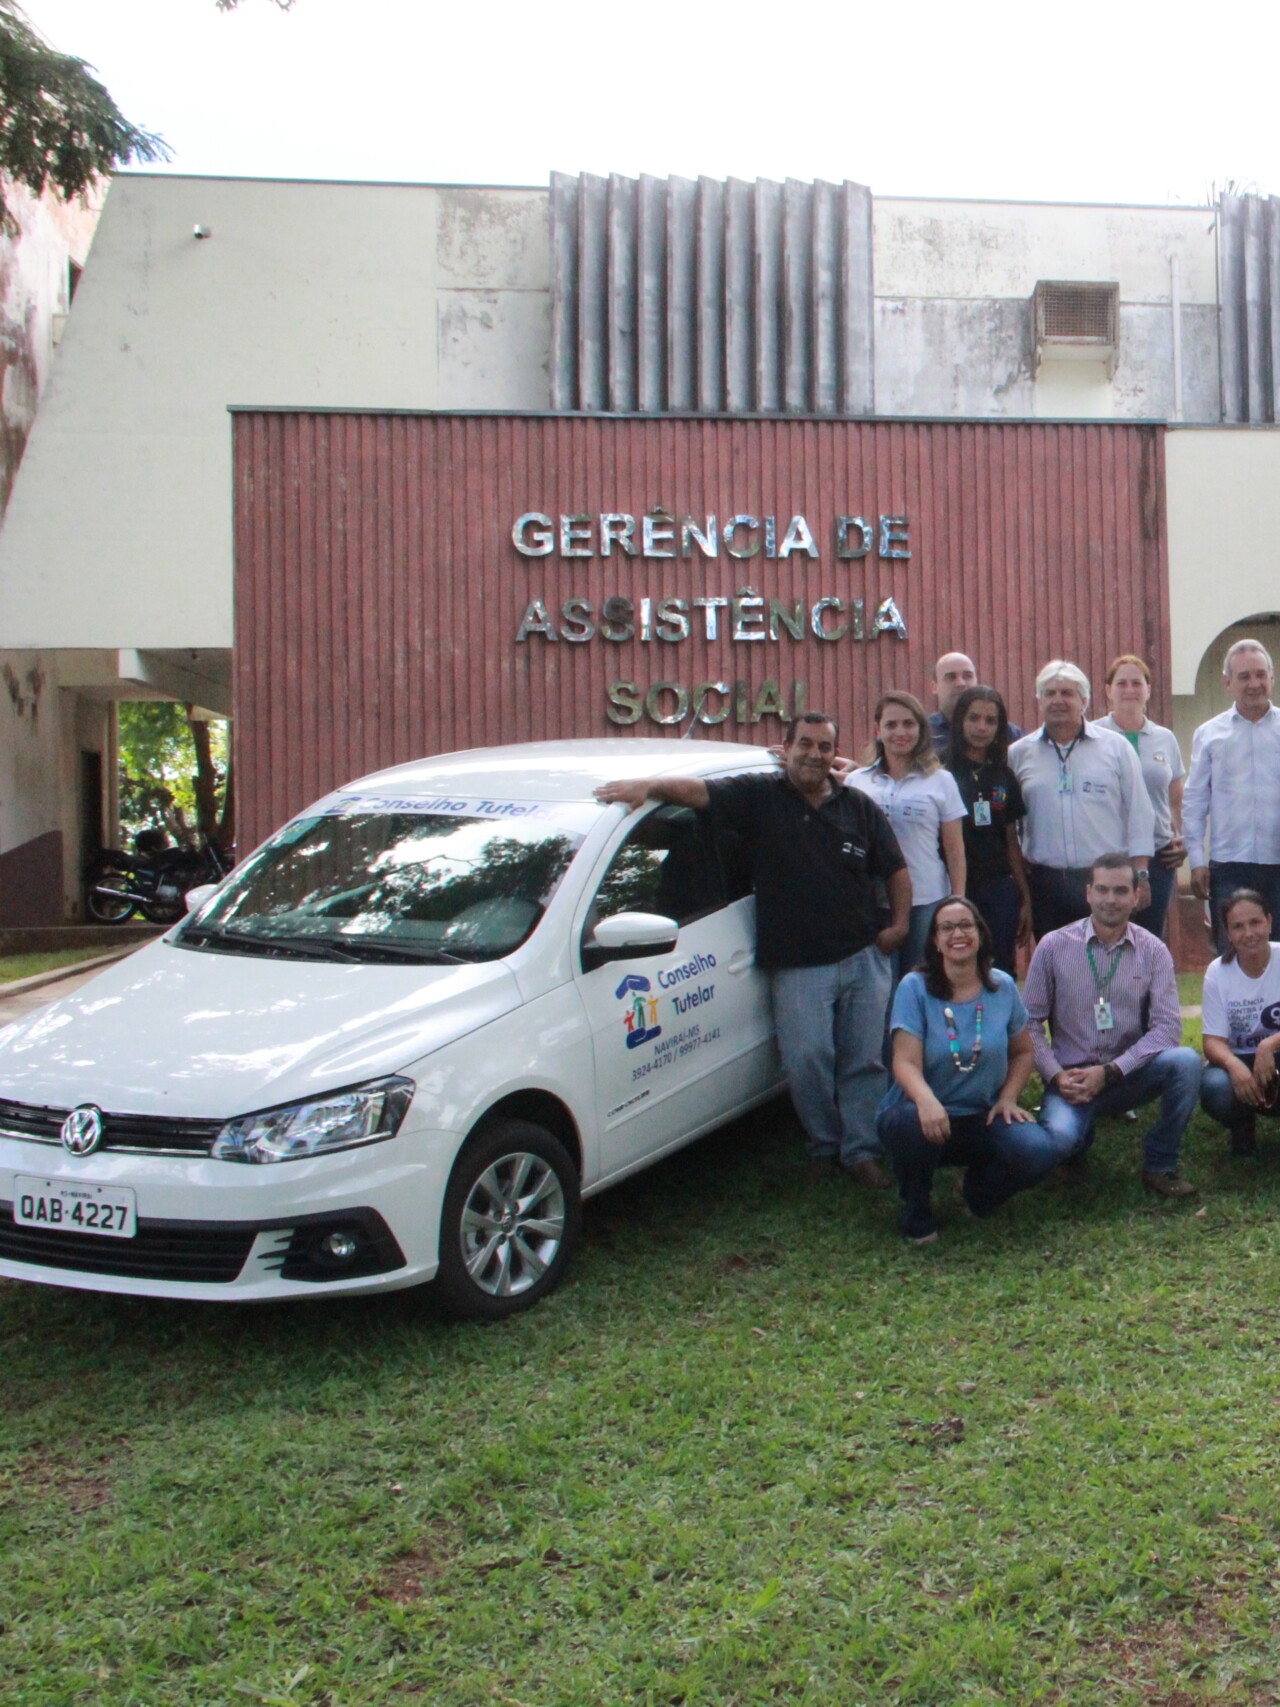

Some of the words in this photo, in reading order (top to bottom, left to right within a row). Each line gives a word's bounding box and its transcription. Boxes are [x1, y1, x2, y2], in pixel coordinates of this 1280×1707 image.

[511, 505, 819, 559] GERÊNCIA
[835, 514, 912, 559] DE
[515, 586, 909, 642] ASSISTÊNCIA
[657, 954, 717, 989] Conselho
[672, 984, 715, 1015] Tutelar
